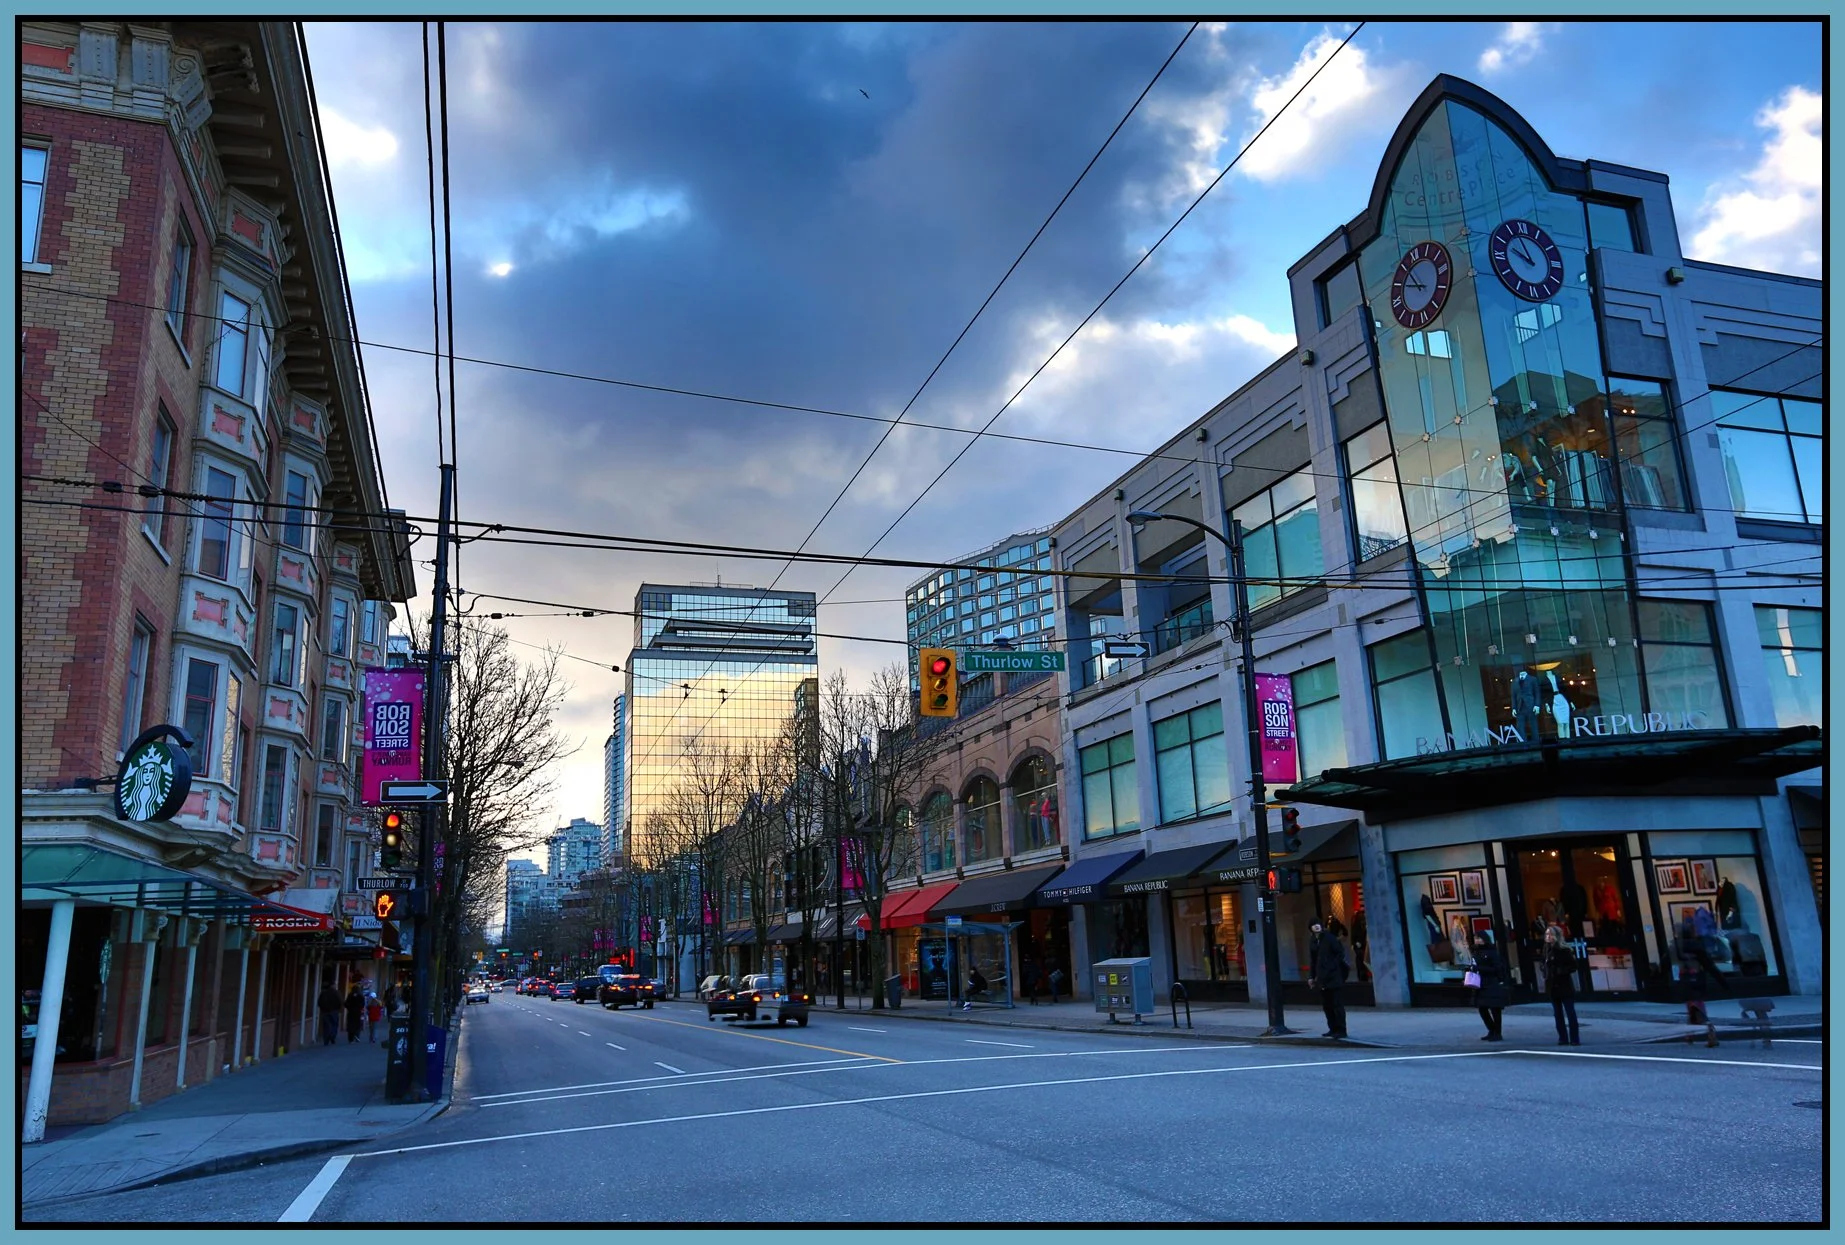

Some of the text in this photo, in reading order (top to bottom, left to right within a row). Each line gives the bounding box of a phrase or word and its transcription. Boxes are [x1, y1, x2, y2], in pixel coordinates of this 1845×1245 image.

[971, 654, 1058, 669] Thurlow St
[1264, 702, 1288, 715] ROB
[1265, 714, 1289, 727] SON
[1266, 729, 1289, 737] STREET
[1219, 870, 1245, 881] BANANA
[363, 879, 396, 888] THURLOW
[1123, 879, 1169, 893] BANANA REPUBLIC
[1043, 885, 1093, 898] TOMMY HILFIGER
